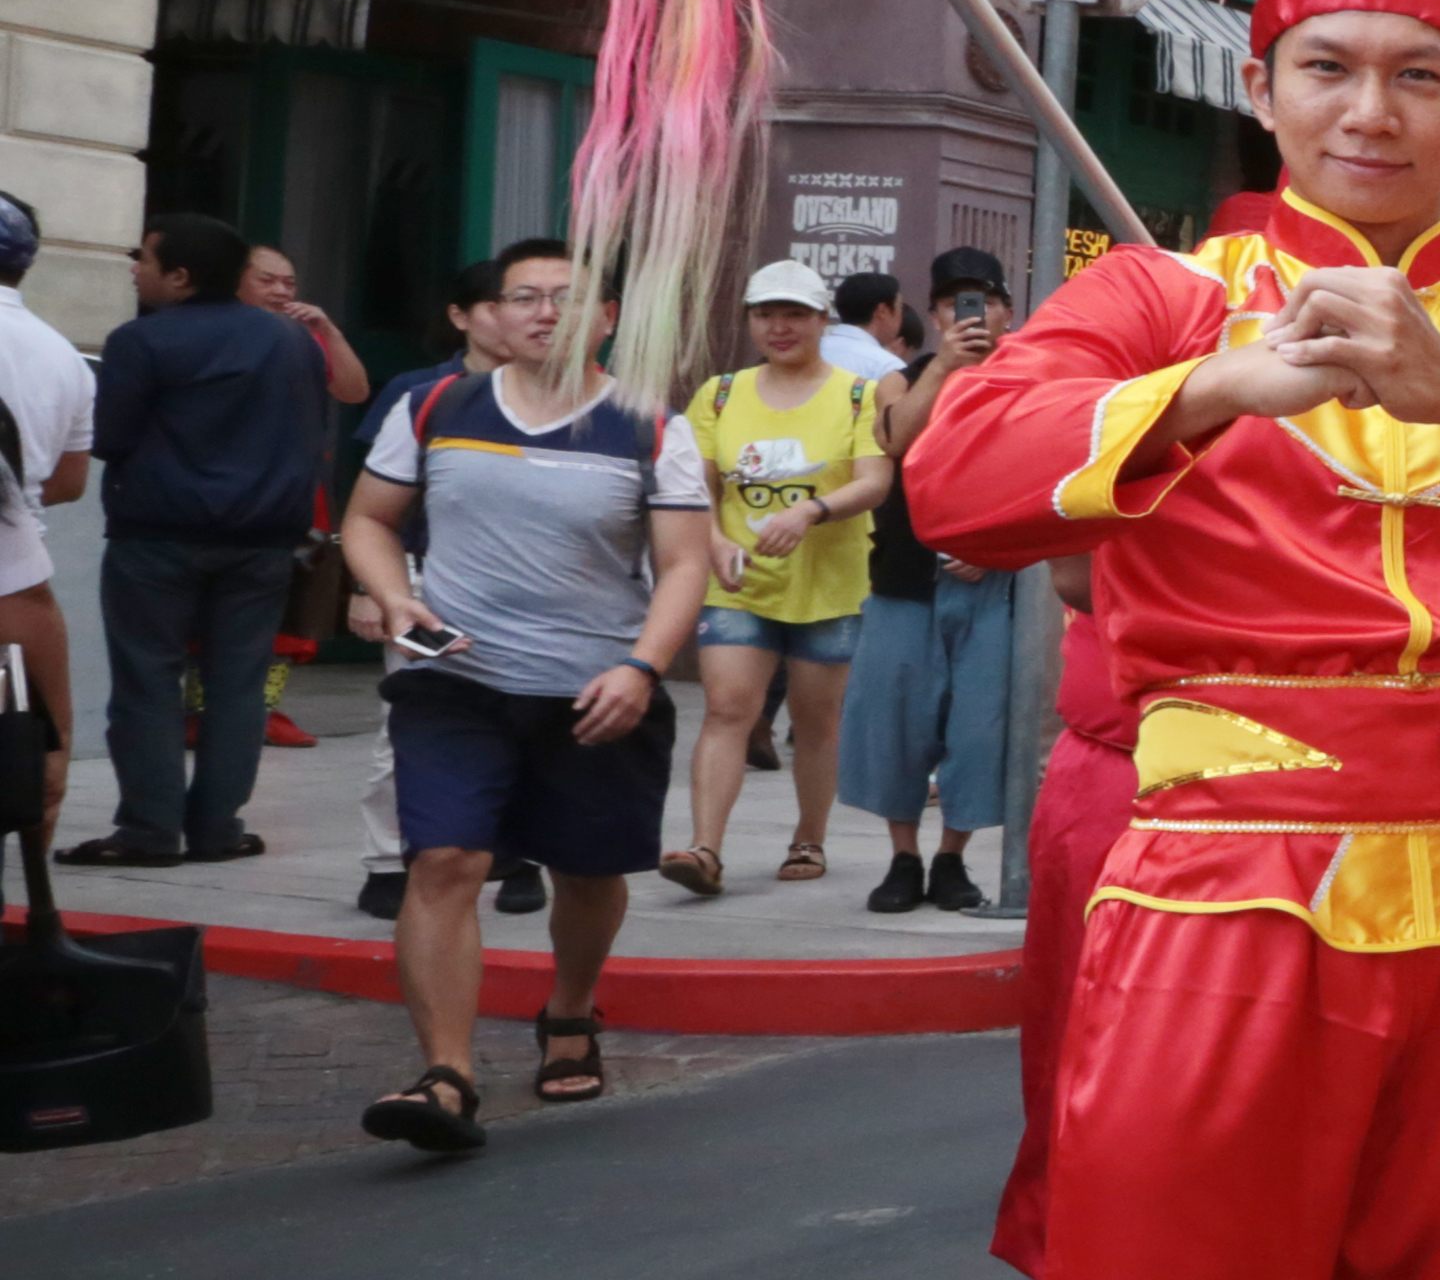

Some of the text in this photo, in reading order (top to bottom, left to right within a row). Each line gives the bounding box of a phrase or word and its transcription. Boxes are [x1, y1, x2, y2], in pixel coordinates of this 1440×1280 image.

[793, 194, 898, 235] OVERLAND
[790, 242, 895, 277] TICKET
[1064, 228, 1110, 256] ESH
